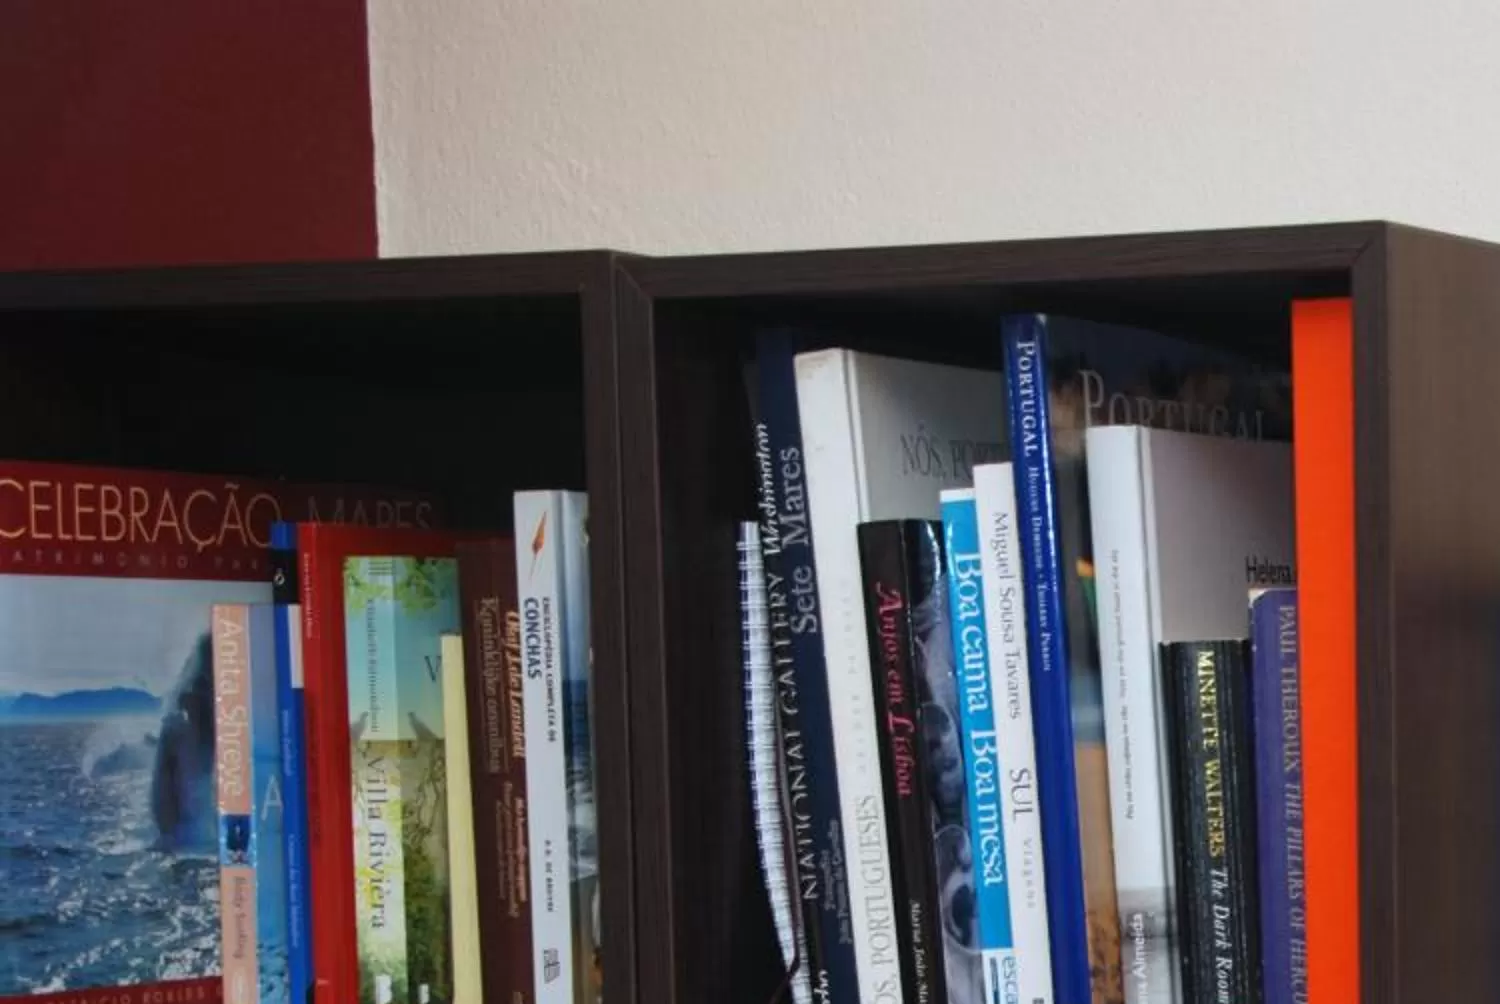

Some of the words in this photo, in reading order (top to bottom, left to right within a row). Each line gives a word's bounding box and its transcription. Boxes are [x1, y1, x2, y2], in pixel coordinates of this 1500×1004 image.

[1015, 340, 1039, 458] PORTUGAL
[0, 480, 281, 553] CELEBRAÇÃO
[778, 446, 809, 549] Mares
[991, 511, 1016, 580] Miguel
[789, 565, 818, 635] Sete
[875, 581, 904, 662] Anjos
[954, 552, 982, 621] Boa
[998, 586, 1018, 644] Sousa
[219, 618, 246, 696] Anita
[524, 596, 543, 680] CONCHAS
[1278, 604, 1298, 658] PAUL
[884, 668, 906, 704] em
[961, 625, 990, 713] cama
[1003, 649, 1023, 721] Tavares
[1197, 651, 1219, 749] MINETTE
[223, 704, 248, 797] Shreve
[887, 710, 916, 797] Lisboa
[1280, 664, 1301, 772] THEROUX
[367, 756, 388, 821] Villa
[970, 728, 997, 797] Boa
[1009, 767, 1033, 824] SUL
[1204, 758, 1225, 858] WALTERS
[1285, 782, 1303, 821] THE
[855, 794, 894, 967] PORTUGUESES
[977, 803, 1006, 887] mesa
[1286, 826, 1304, 900] PILLARS
[1210, 867, 1229, 897] The
[1211, 902, 1231, 950] Dark
[1288, 906, 1305, 932] OF
[1215, 956, 1233, 1004] Room
